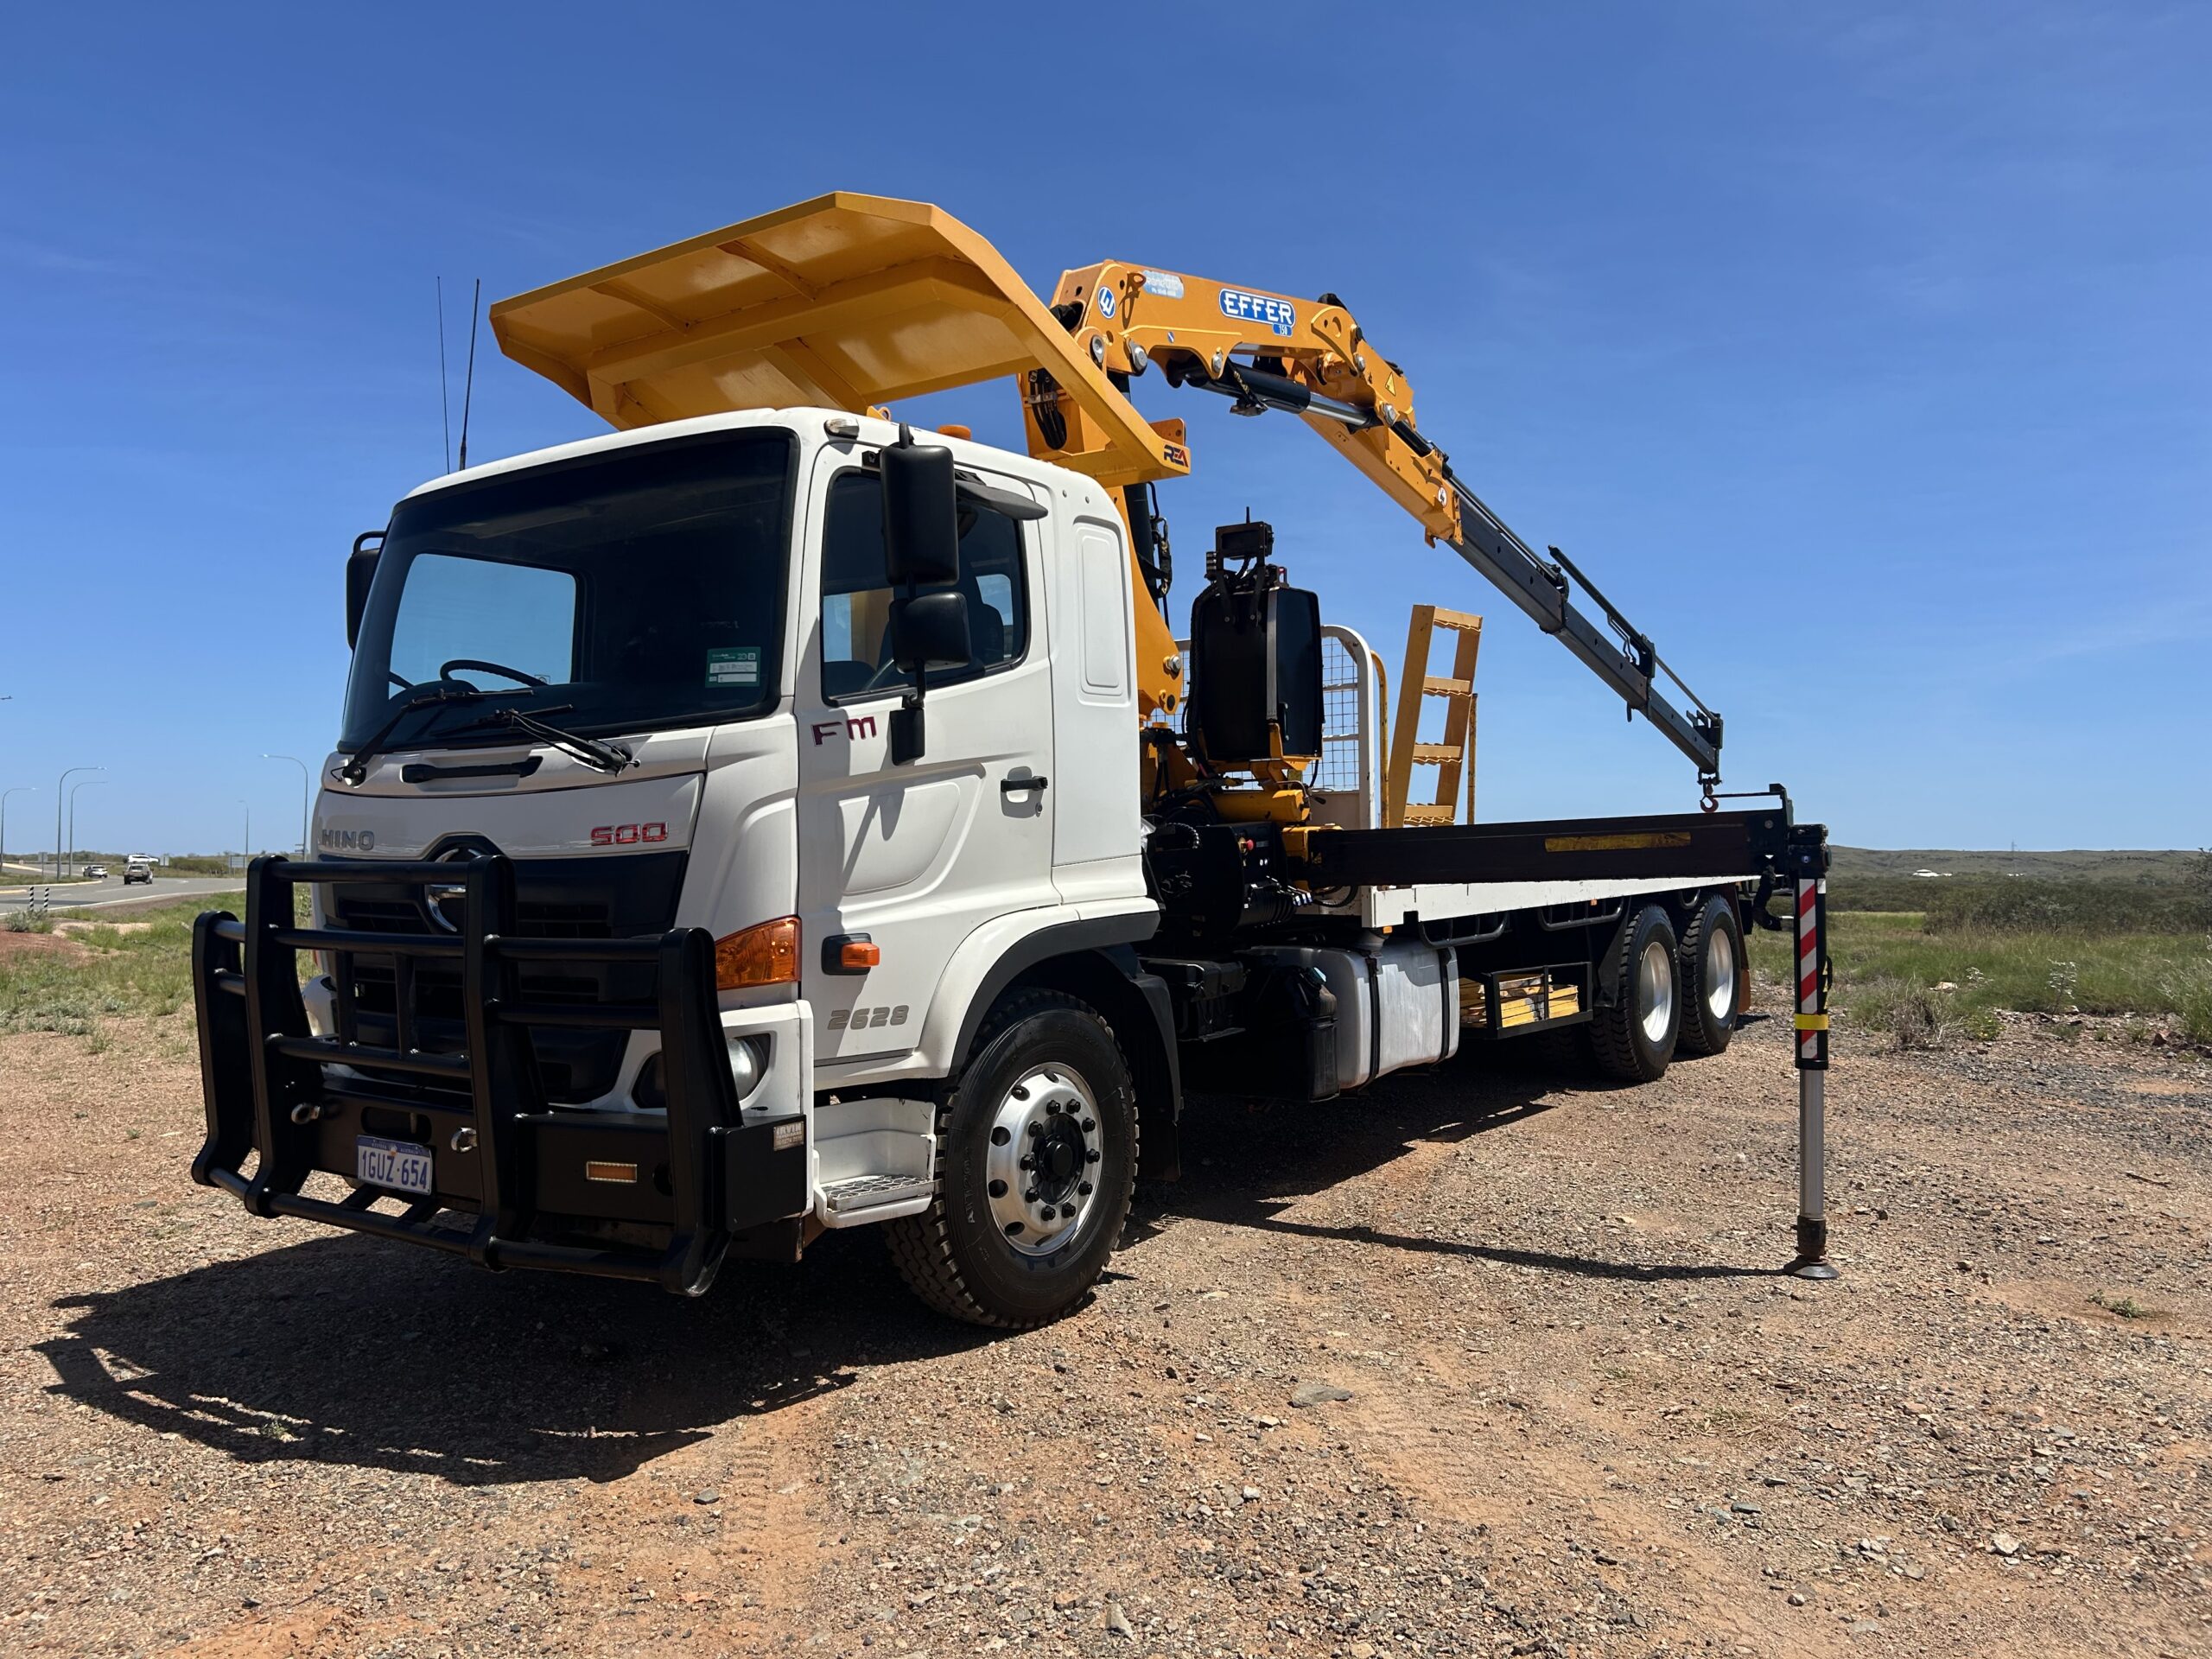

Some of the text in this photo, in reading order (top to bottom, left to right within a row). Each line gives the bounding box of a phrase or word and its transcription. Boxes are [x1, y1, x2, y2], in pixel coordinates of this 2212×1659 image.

[1224, 292, 1293, 325] EFFER
[1163, 444, 1189, 468] REA
[322, 830, 374, 851] HINO
[591, 822, 669, 846] 500
[827, 1005, 910, 1030] 2628
